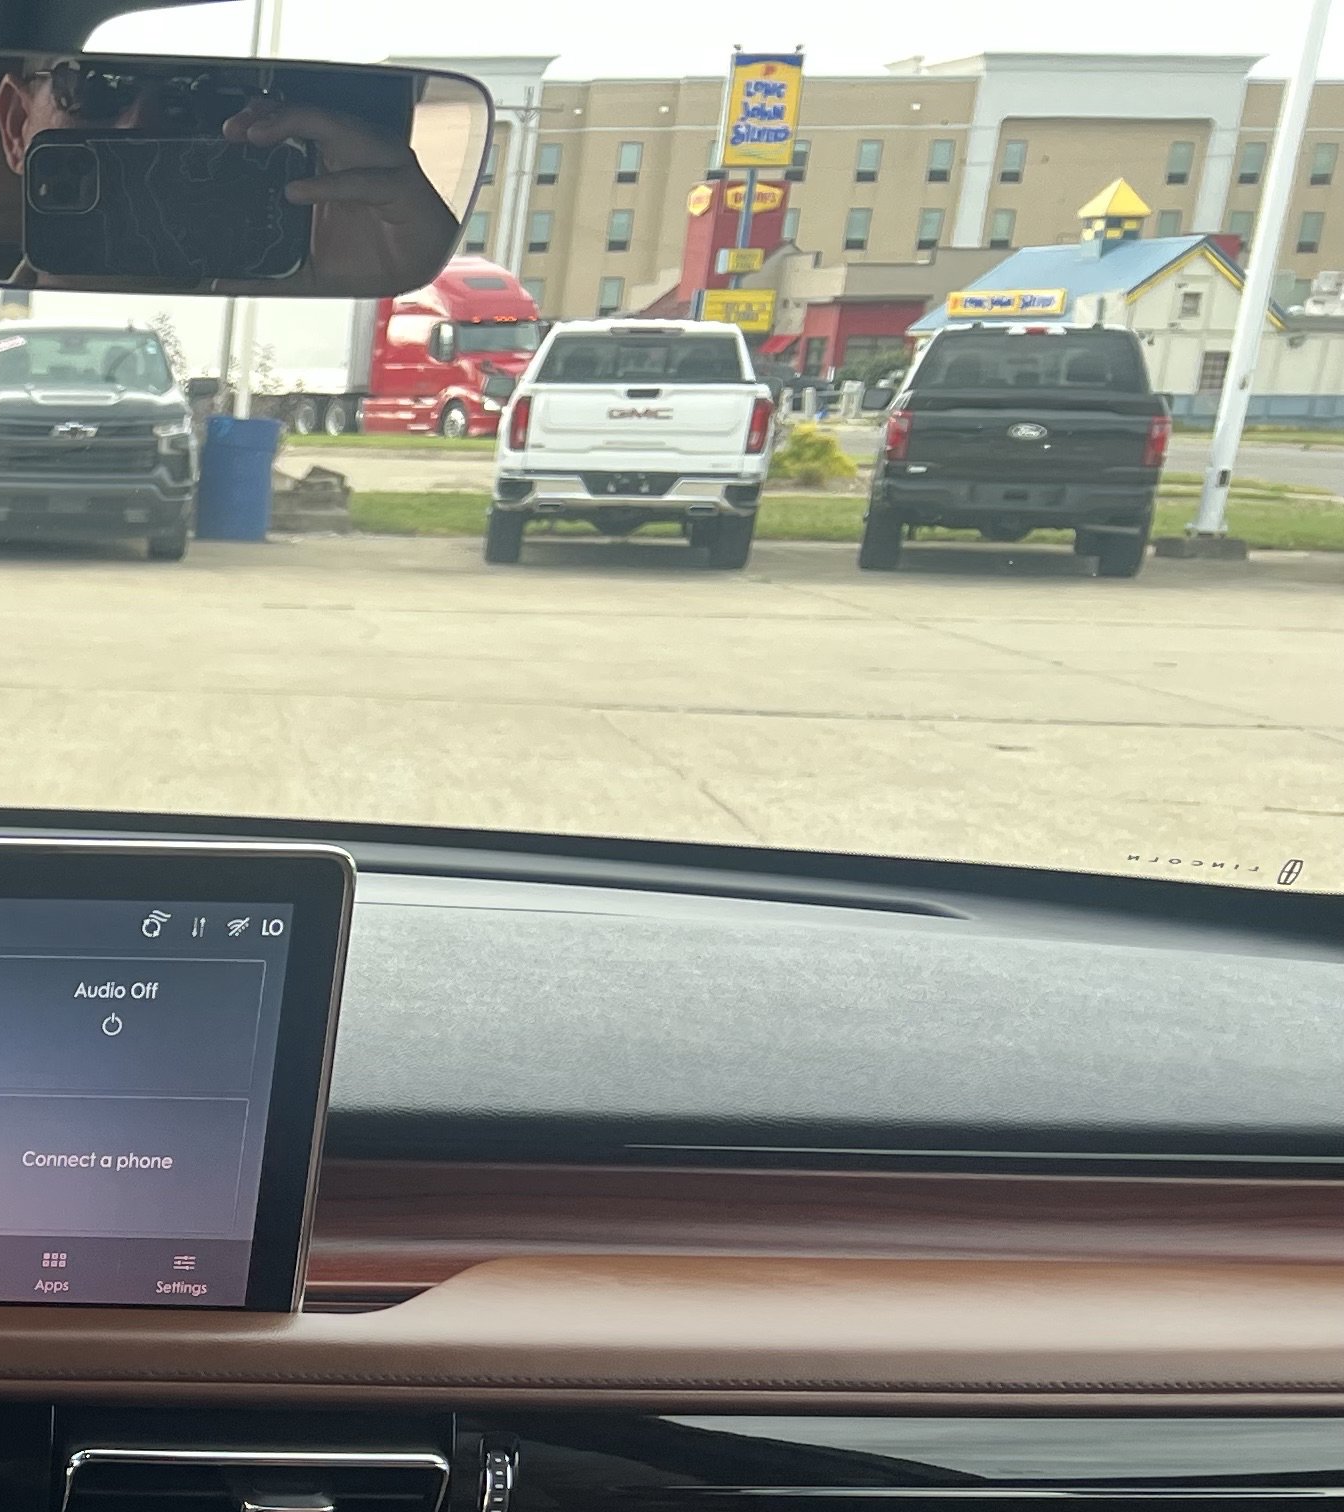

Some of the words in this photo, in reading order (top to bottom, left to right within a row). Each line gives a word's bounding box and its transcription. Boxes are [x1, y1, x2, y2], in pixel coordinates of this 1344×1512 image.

[607, 408, 674, 420] GMC
[261, 918, 285, 937] LO
[73, 981, 126, 999] Audio
[130, 981, 159, 1000] Off
[22, 1150, 97, 1168] Connect
[100, 1156, 112, 1168] a
[115, 1152, 173, 1172] phone
[34, 1279, 70, 1294] Apps
[155, 1280, 208, 1297] Settings
